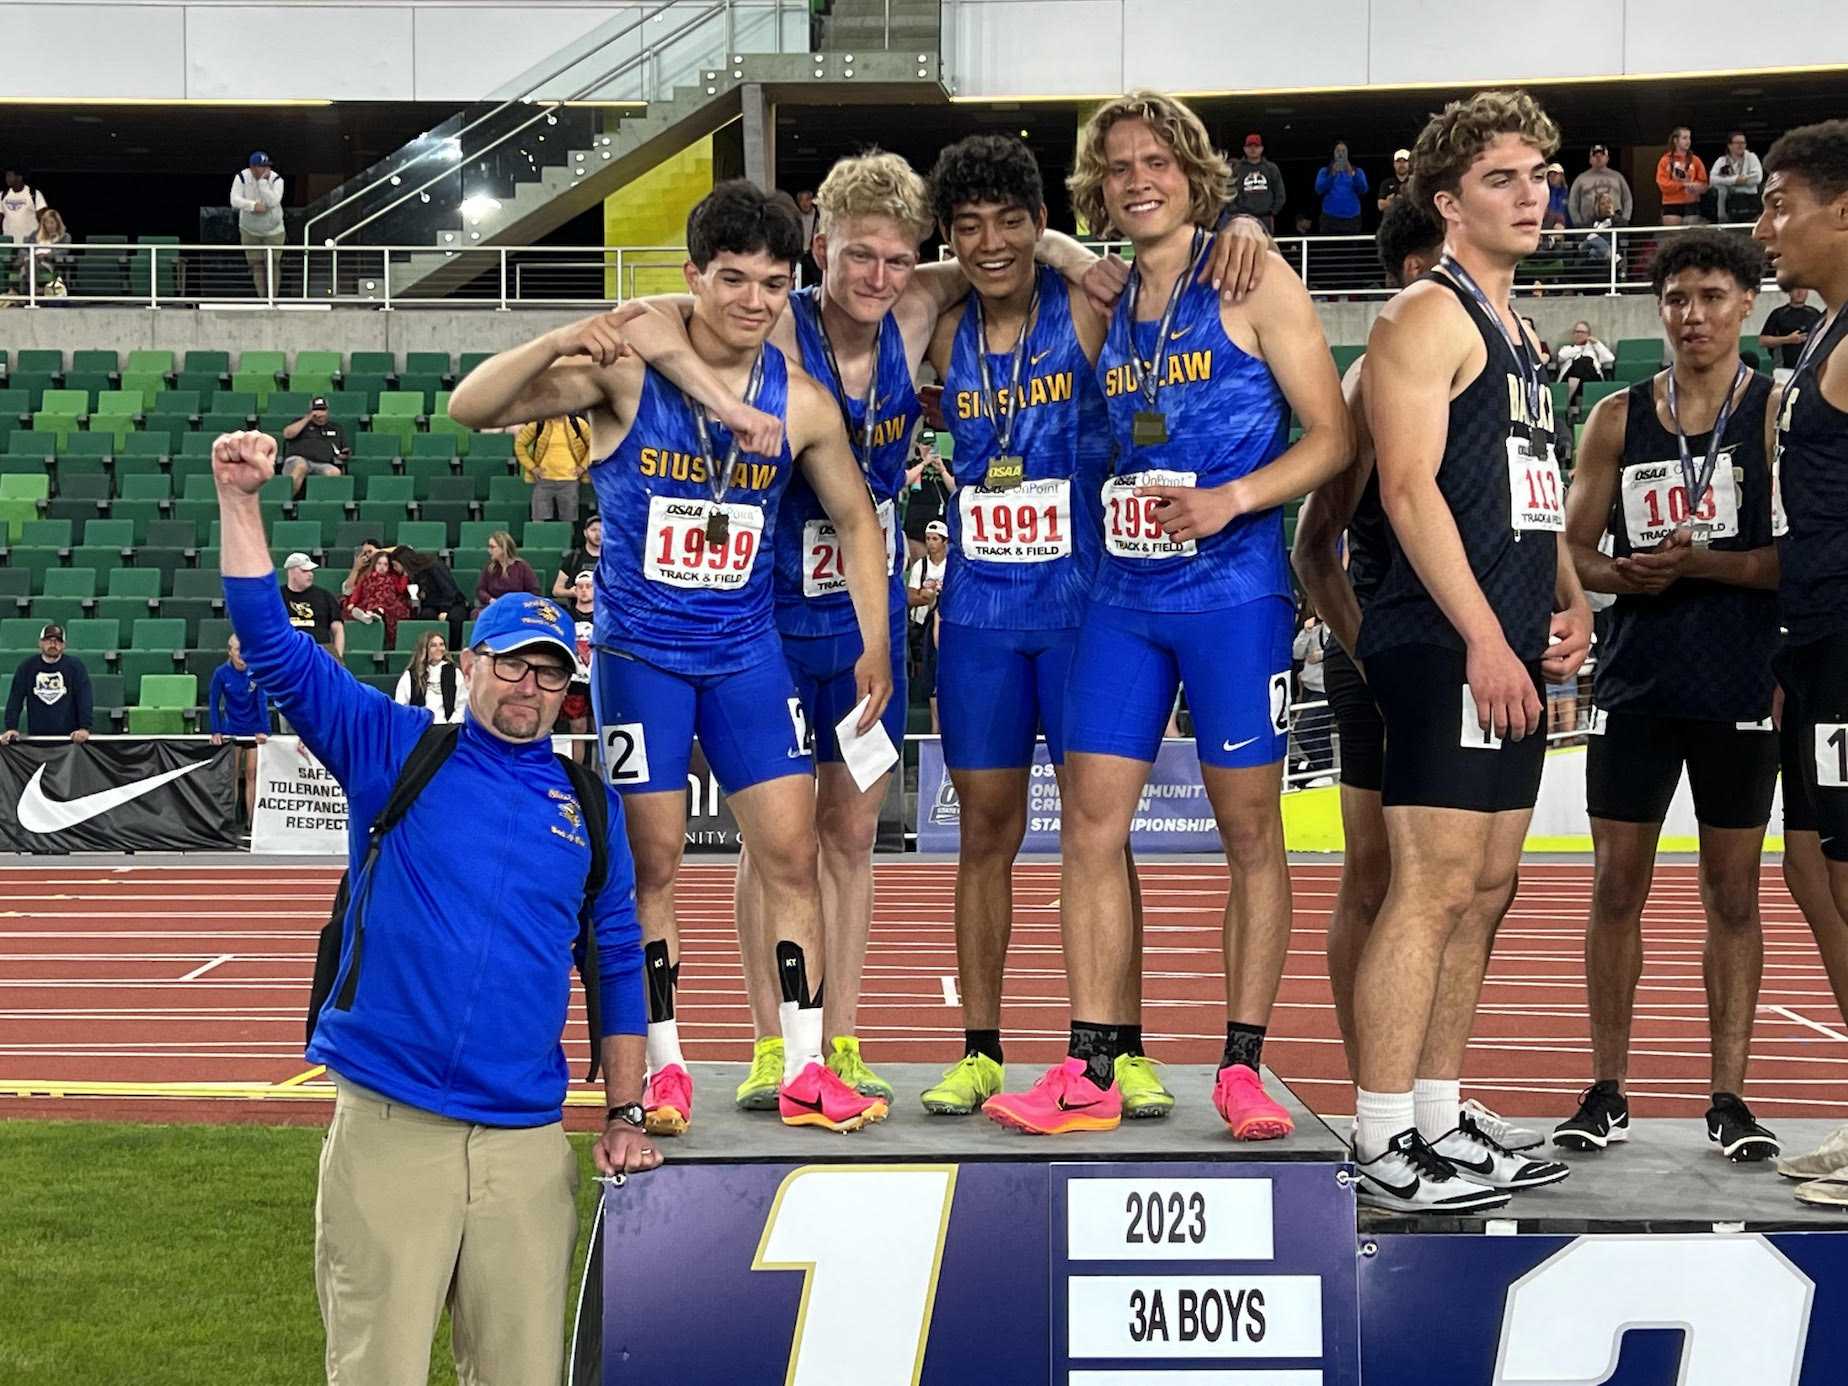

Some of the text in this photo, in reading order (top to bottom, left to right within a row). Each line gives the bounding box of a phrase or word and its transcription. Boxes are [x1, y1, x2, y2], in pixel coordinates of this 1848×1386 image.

[1105, 350, 1212, 397] SIUAW
[640, 447, 777, 490] SIUSAW
[1636, 467, 1667, 480] OSAA
[666, 504, 704, 517] OSAA
[1644, 484, 1717, 527] 103
[970, 505, 1063, 543] 1991
[1110, 498, 1163, 539] 199
[656, 526, 754, 570] 1999
[976, 546, 1059, 555] TRACK & FIELD
[1142, 543, 1150, 552] &
[1153, 543, 1184, 552] FIELD
[659, 569, 743, 583] TRACK & FIELD
[817, 579, 846, 590] TRAC
[607, 730, 639, 780] 2
[1826, 728, 1848, 782] 1
[298, 767, 333, 780] SAFE
[268, 780, 345, 797] TOLERANC
[1142, 783, 1208, 798] MUNIT
[257, 797, 350, 814] ACCEPTANCE
[286, 816, 350, 830] RESPECT
[1130, 818, 1219, 832] PIONSHIP
[1126, 1191, 1207, 1244] 2023
[1129, 1288, 1266, 1342] 3A BOYS
